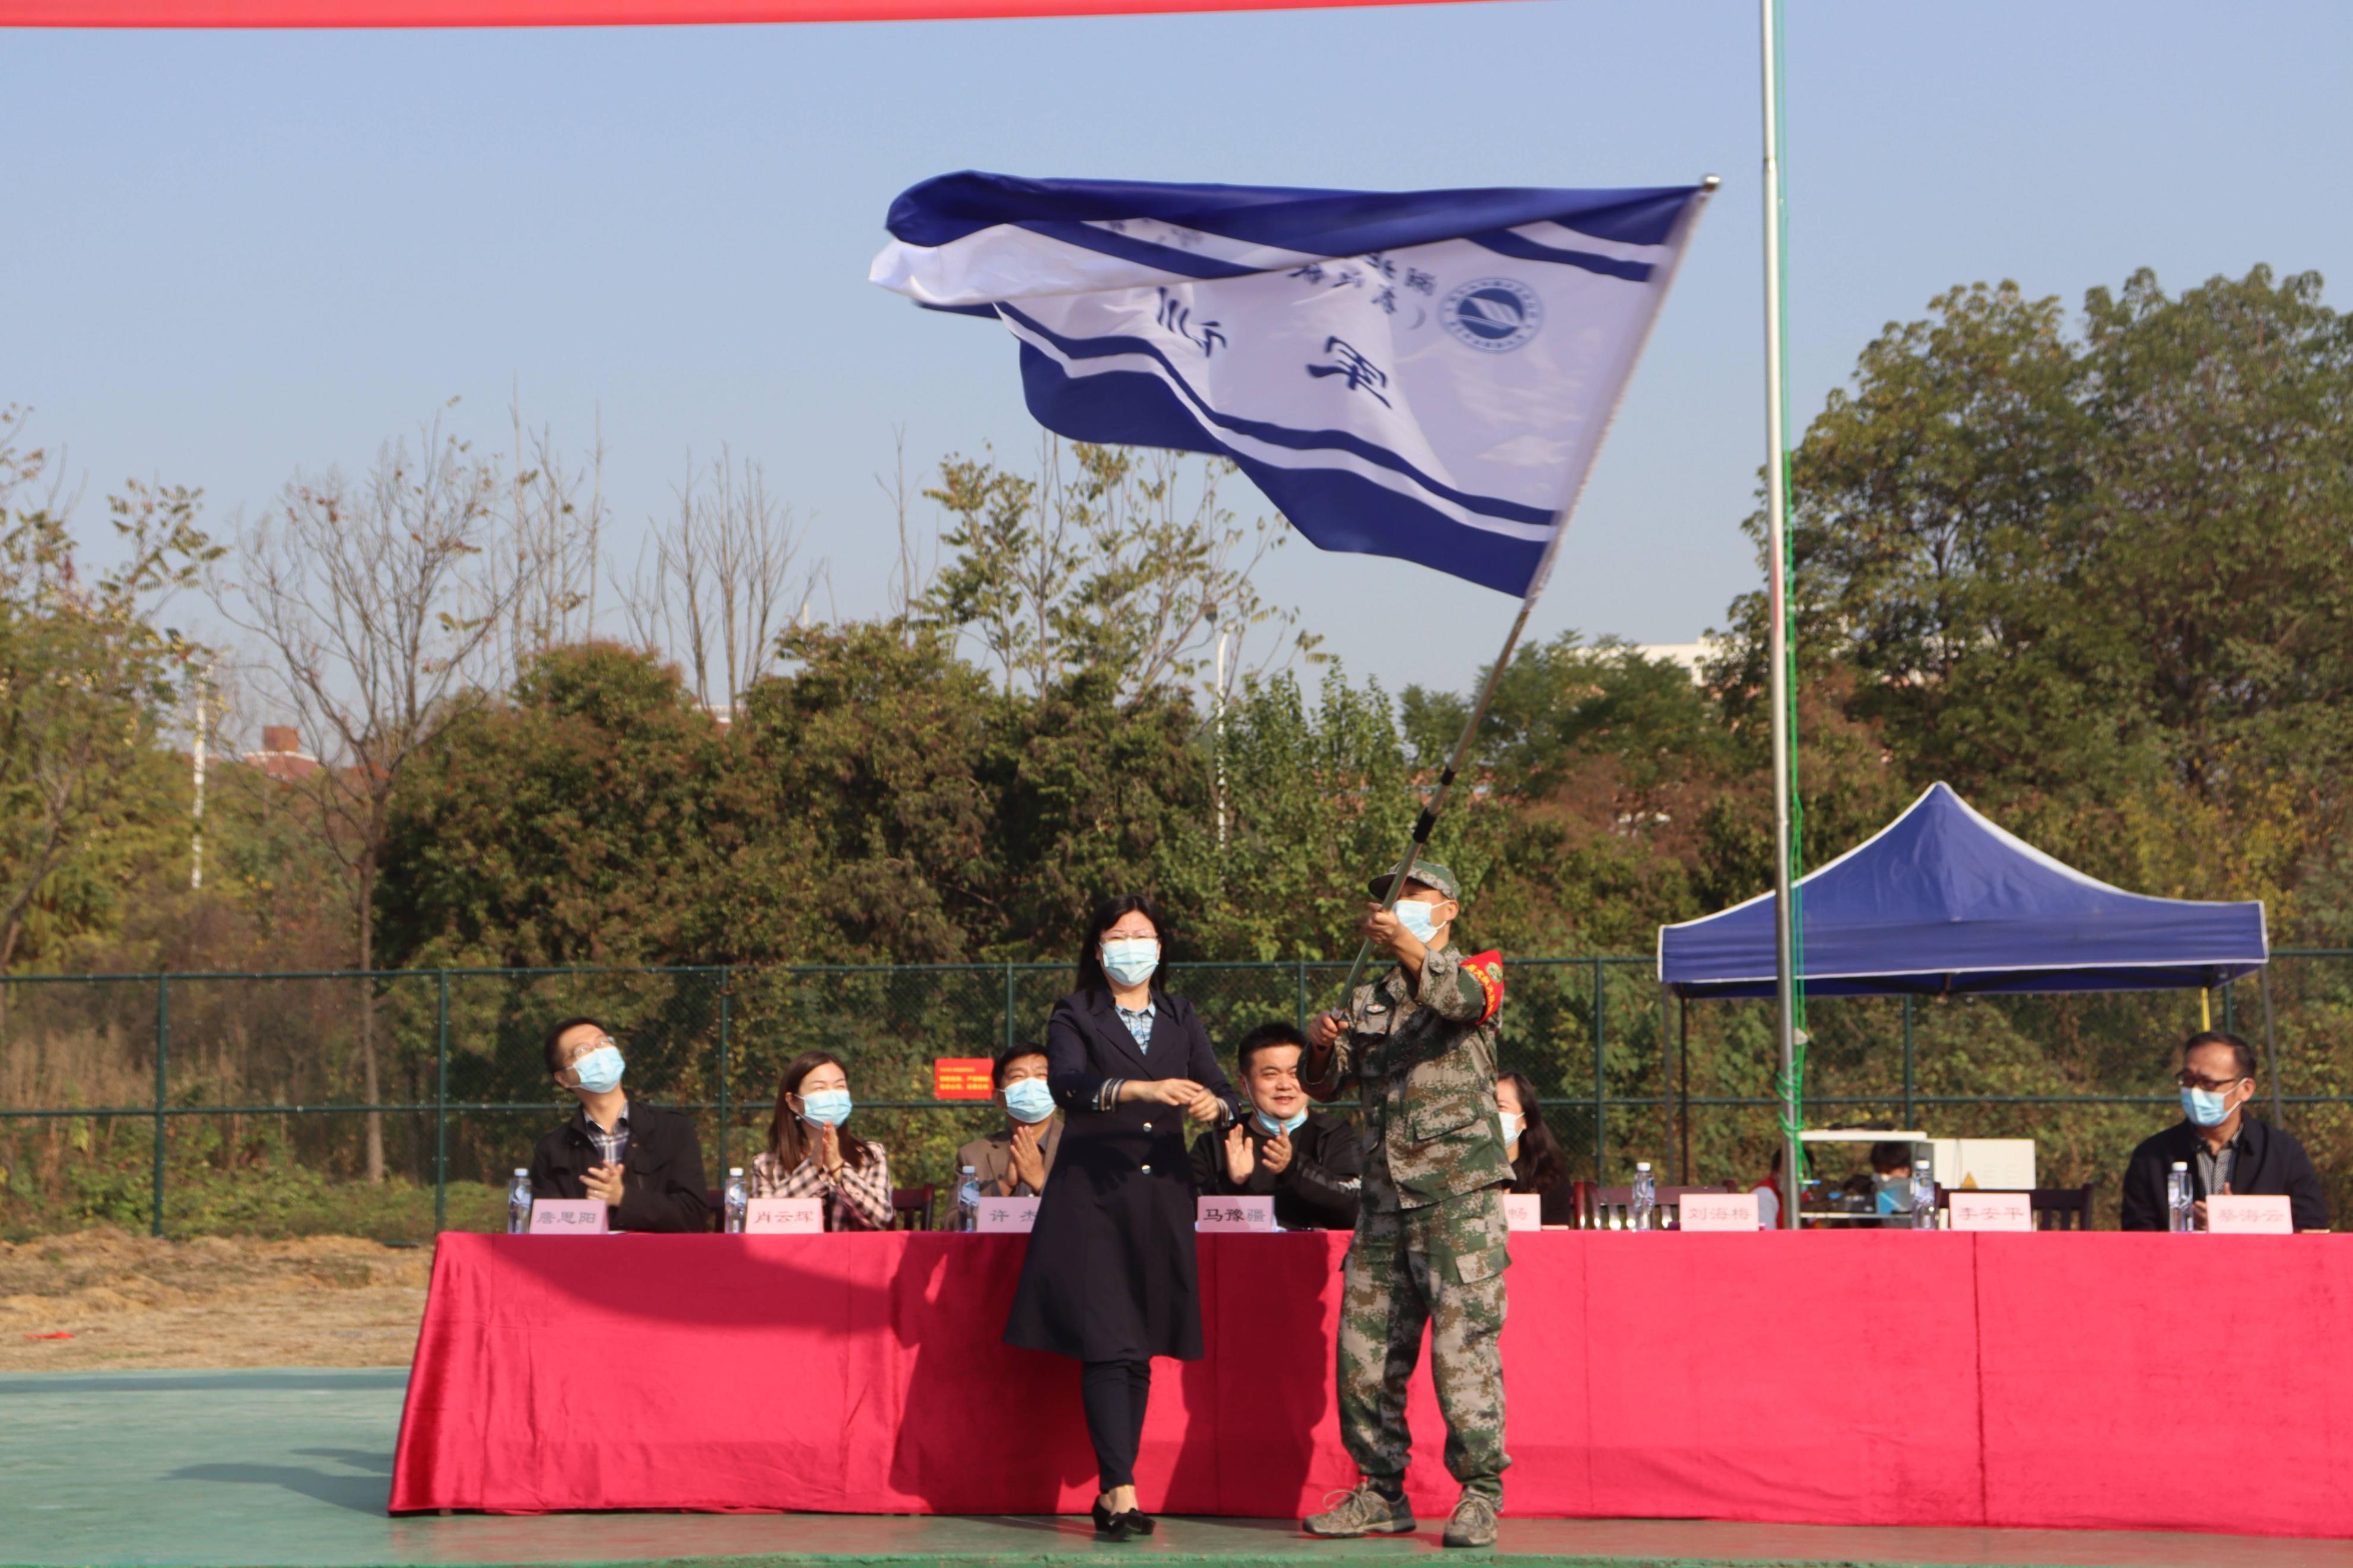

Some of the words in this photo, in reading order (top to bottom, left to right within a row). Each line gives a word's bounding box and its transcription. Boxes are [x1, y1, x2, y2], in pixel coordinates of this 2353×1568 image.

[1688, 1207, 1752, 1221] 刘海梅
[1957, 1207, 2024, 1221] 李安平
